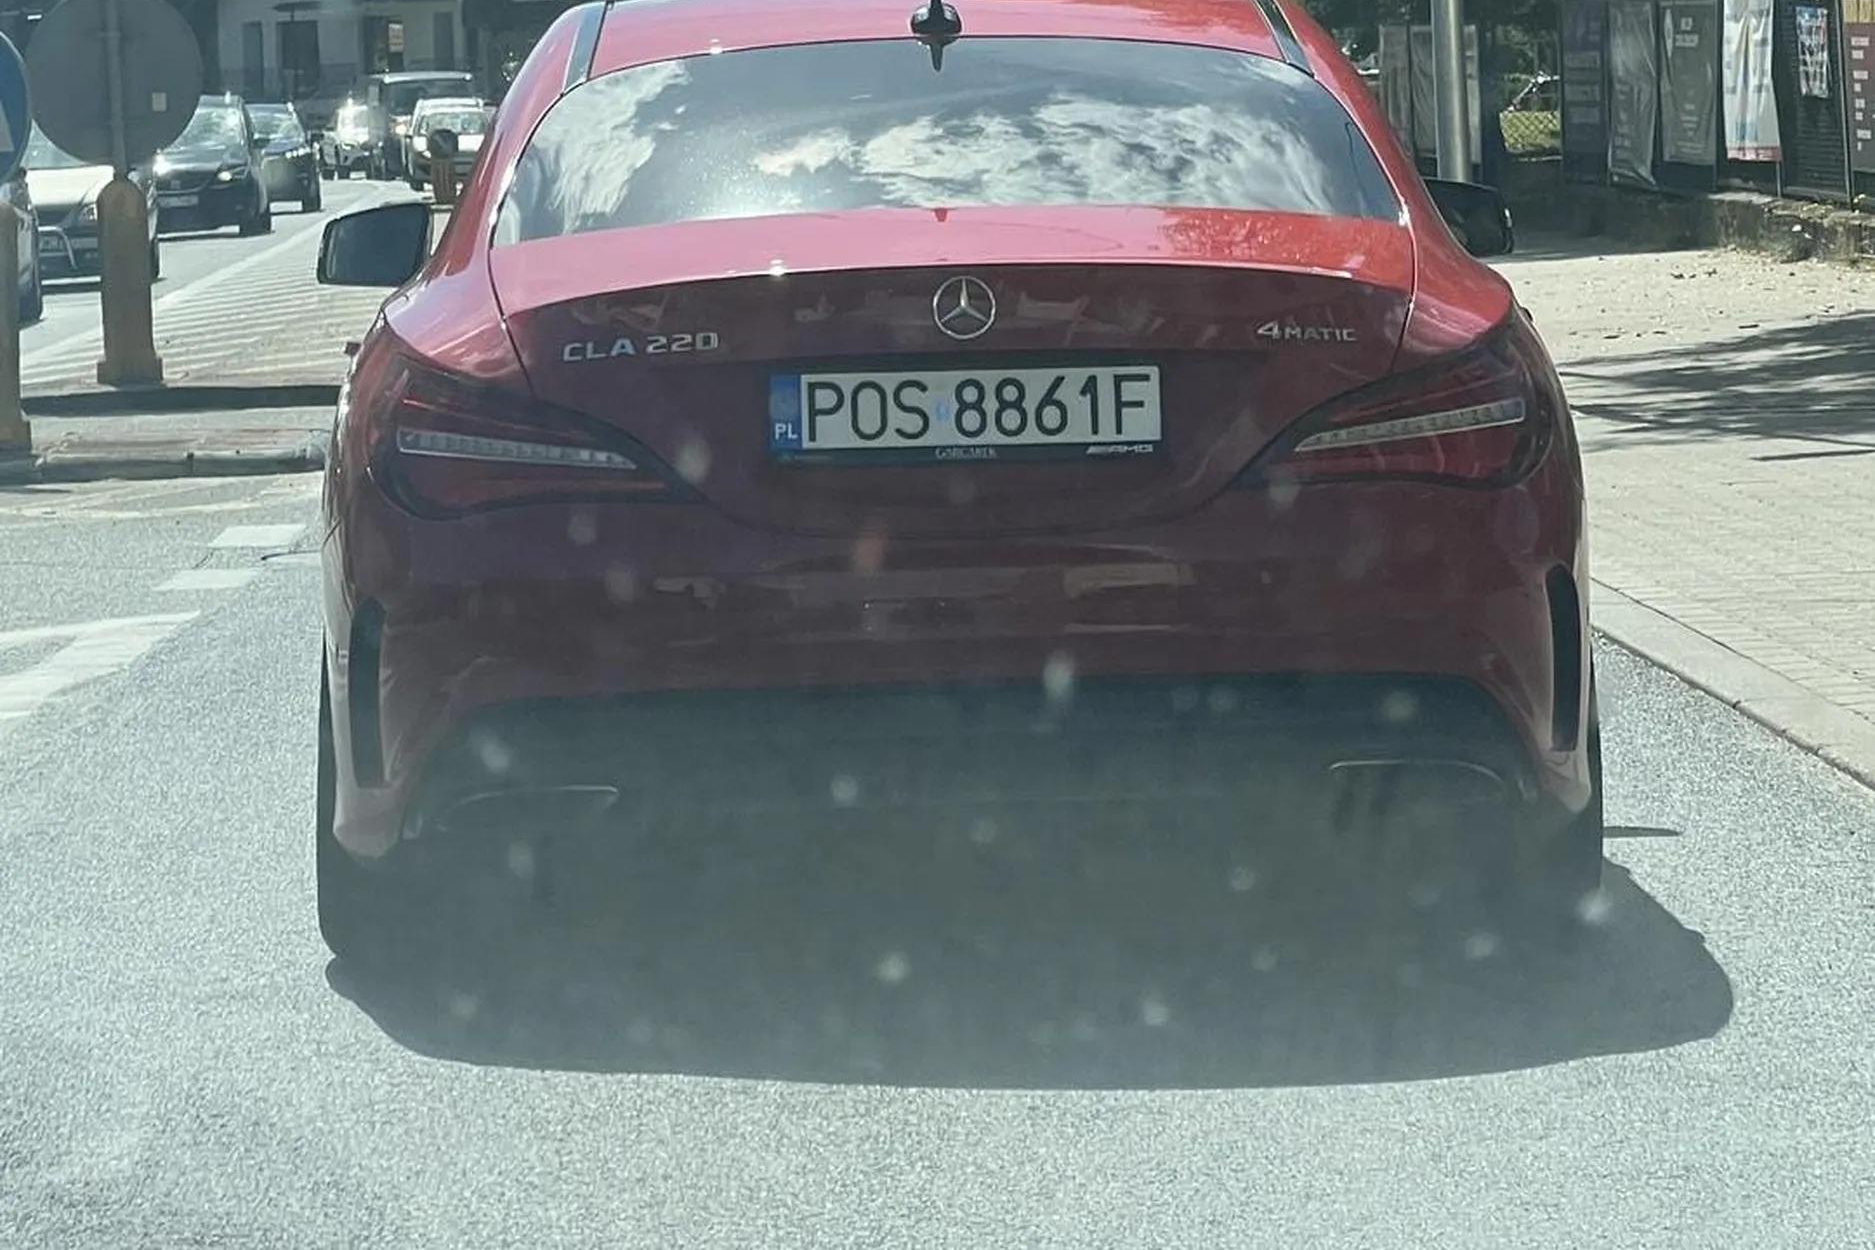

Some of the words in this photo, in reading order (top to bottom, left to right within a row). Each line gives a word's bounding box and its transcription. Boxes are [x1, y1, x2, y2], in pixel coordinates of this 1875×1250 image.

[1257, 320, 1357, 342] 4MATIC
[563, 338, 636, 361] CLA
[646, 332, 719, 354] 220
[807, 380, 930, 442] POS
[955, 374, 1151, 438] 8861F
[774, 423, 798, 440] PL
